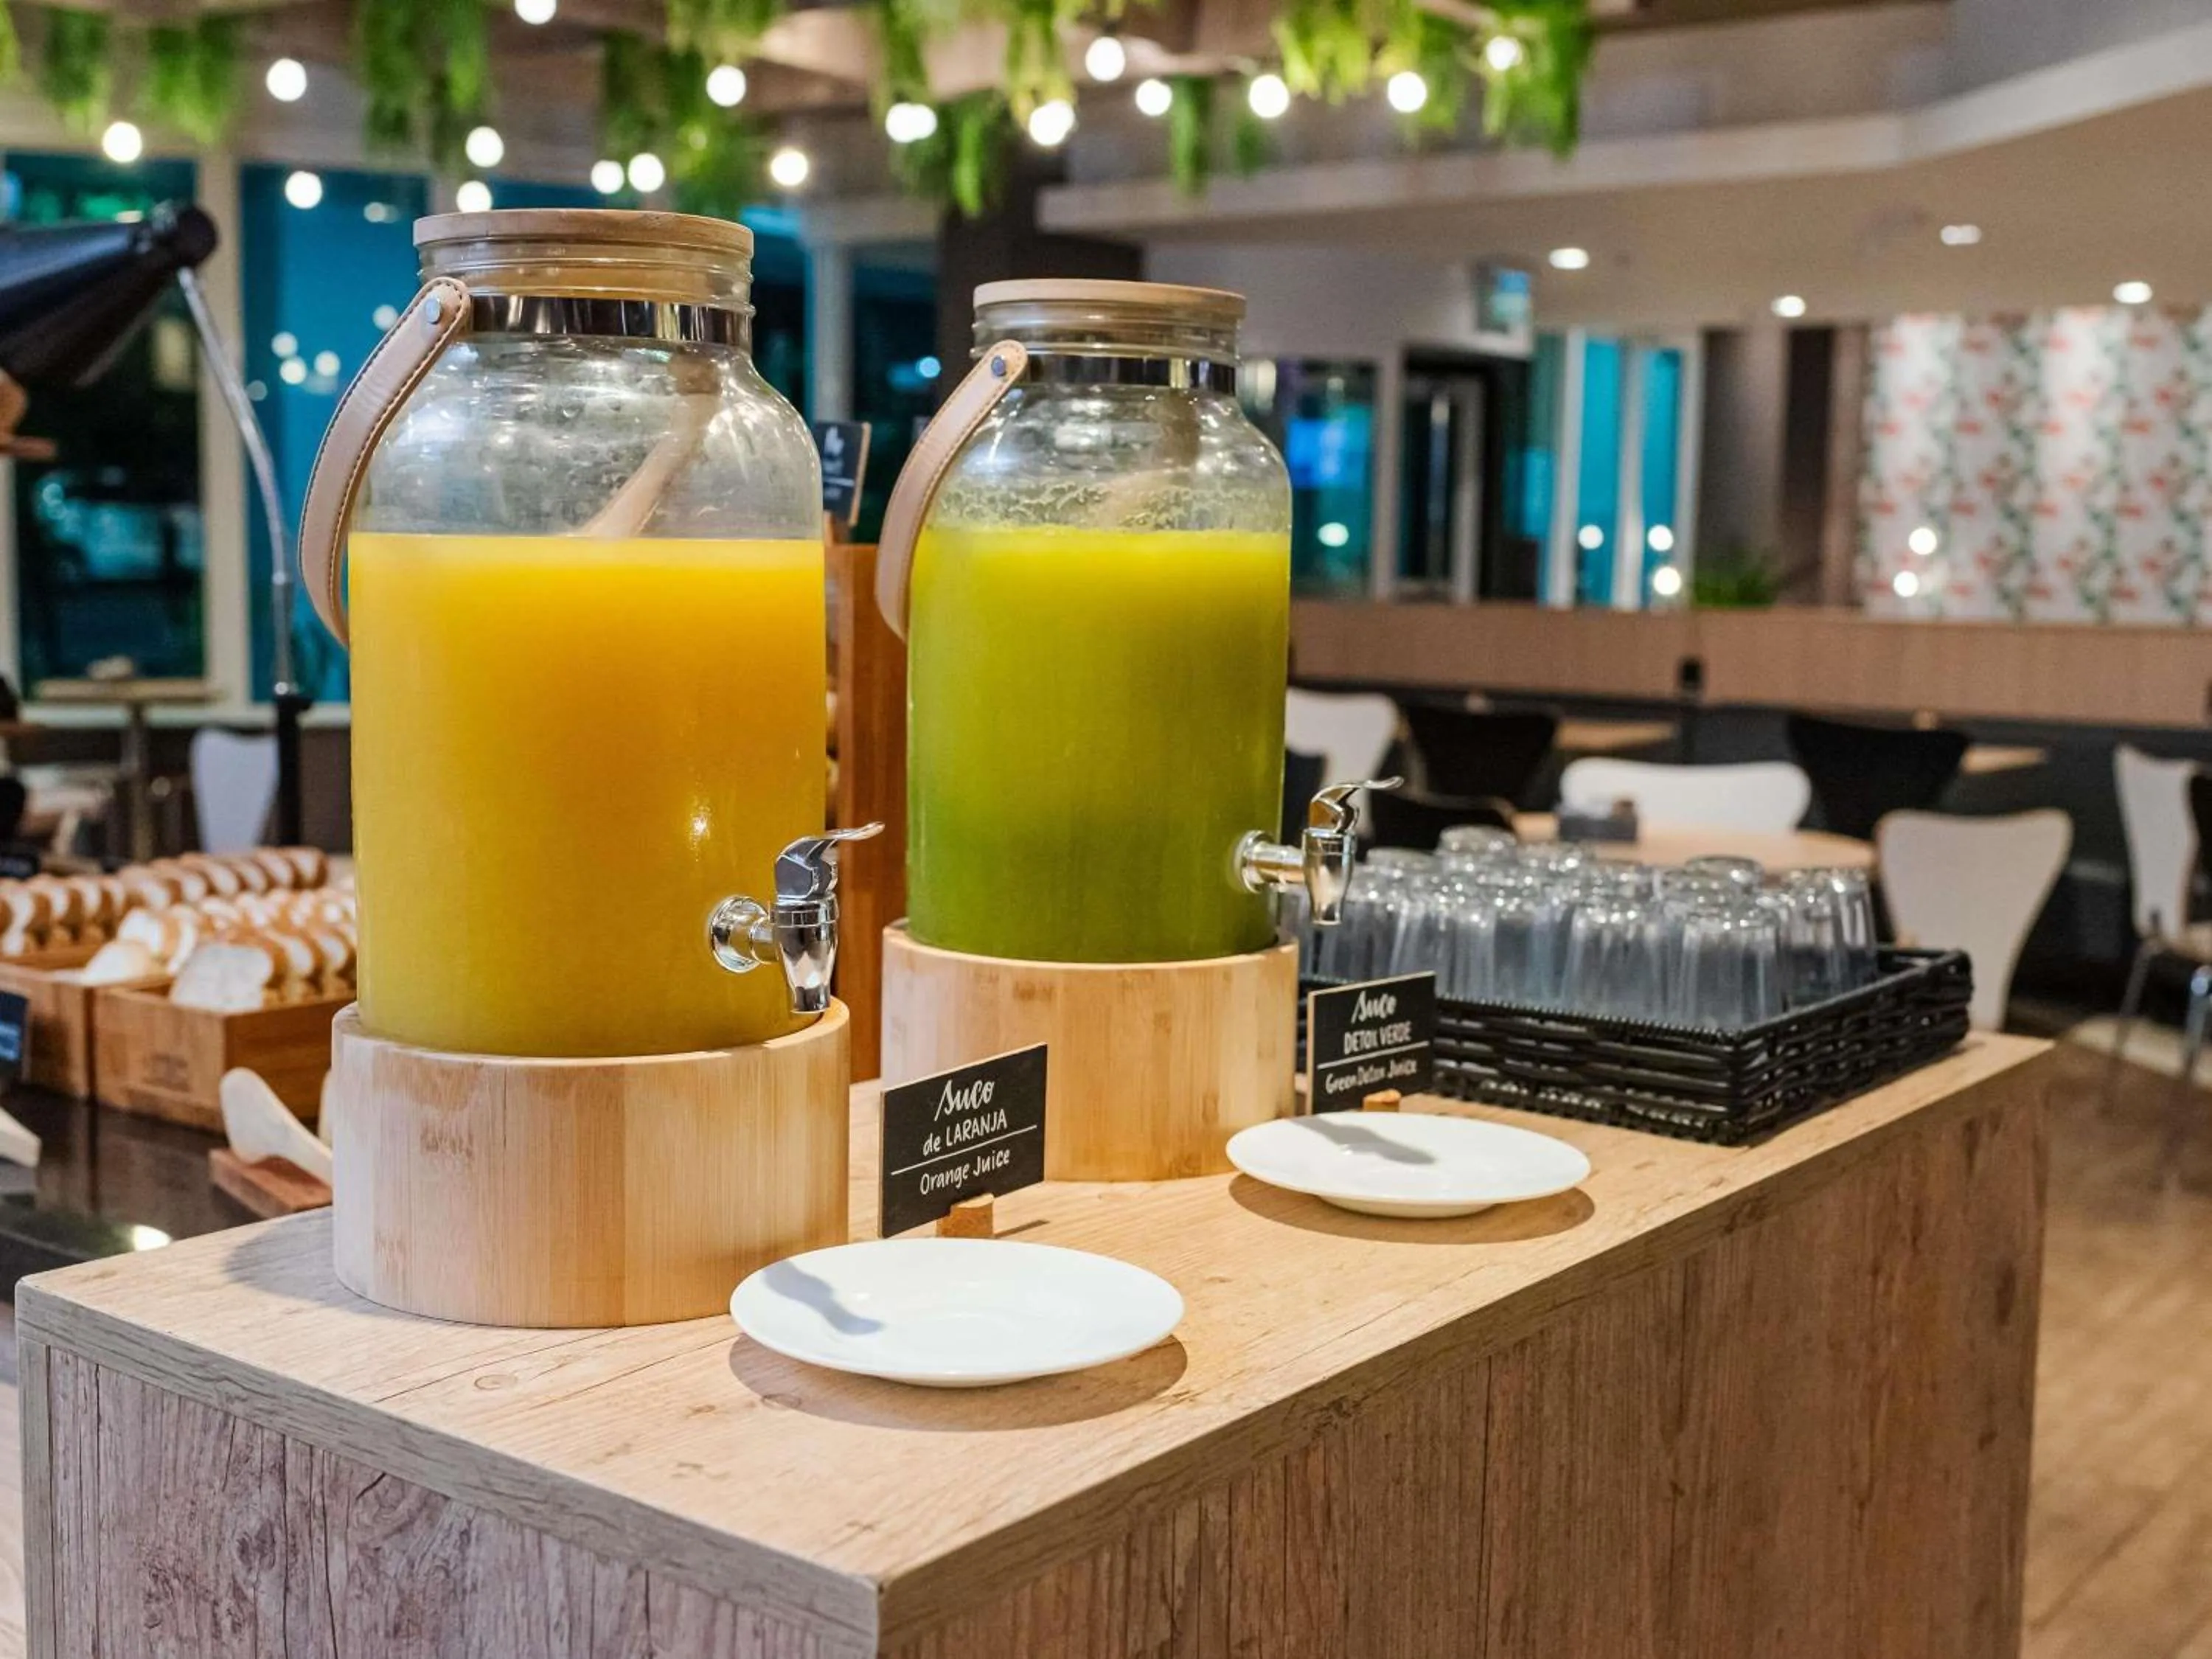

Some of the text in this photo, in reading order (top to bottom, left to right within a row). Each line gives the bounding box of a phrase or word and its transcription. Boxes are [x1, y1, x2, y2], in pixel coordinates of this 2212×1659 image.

[1351, 990, 1397, 1023] Suco
[934, 1079, 995, 1121] Suco
[1325, 1074, 1357, 1094] Green
[923, 1108, 1008, 1156] de LARANJA
[920, 1149, 1010, 1194] Orange Juice
